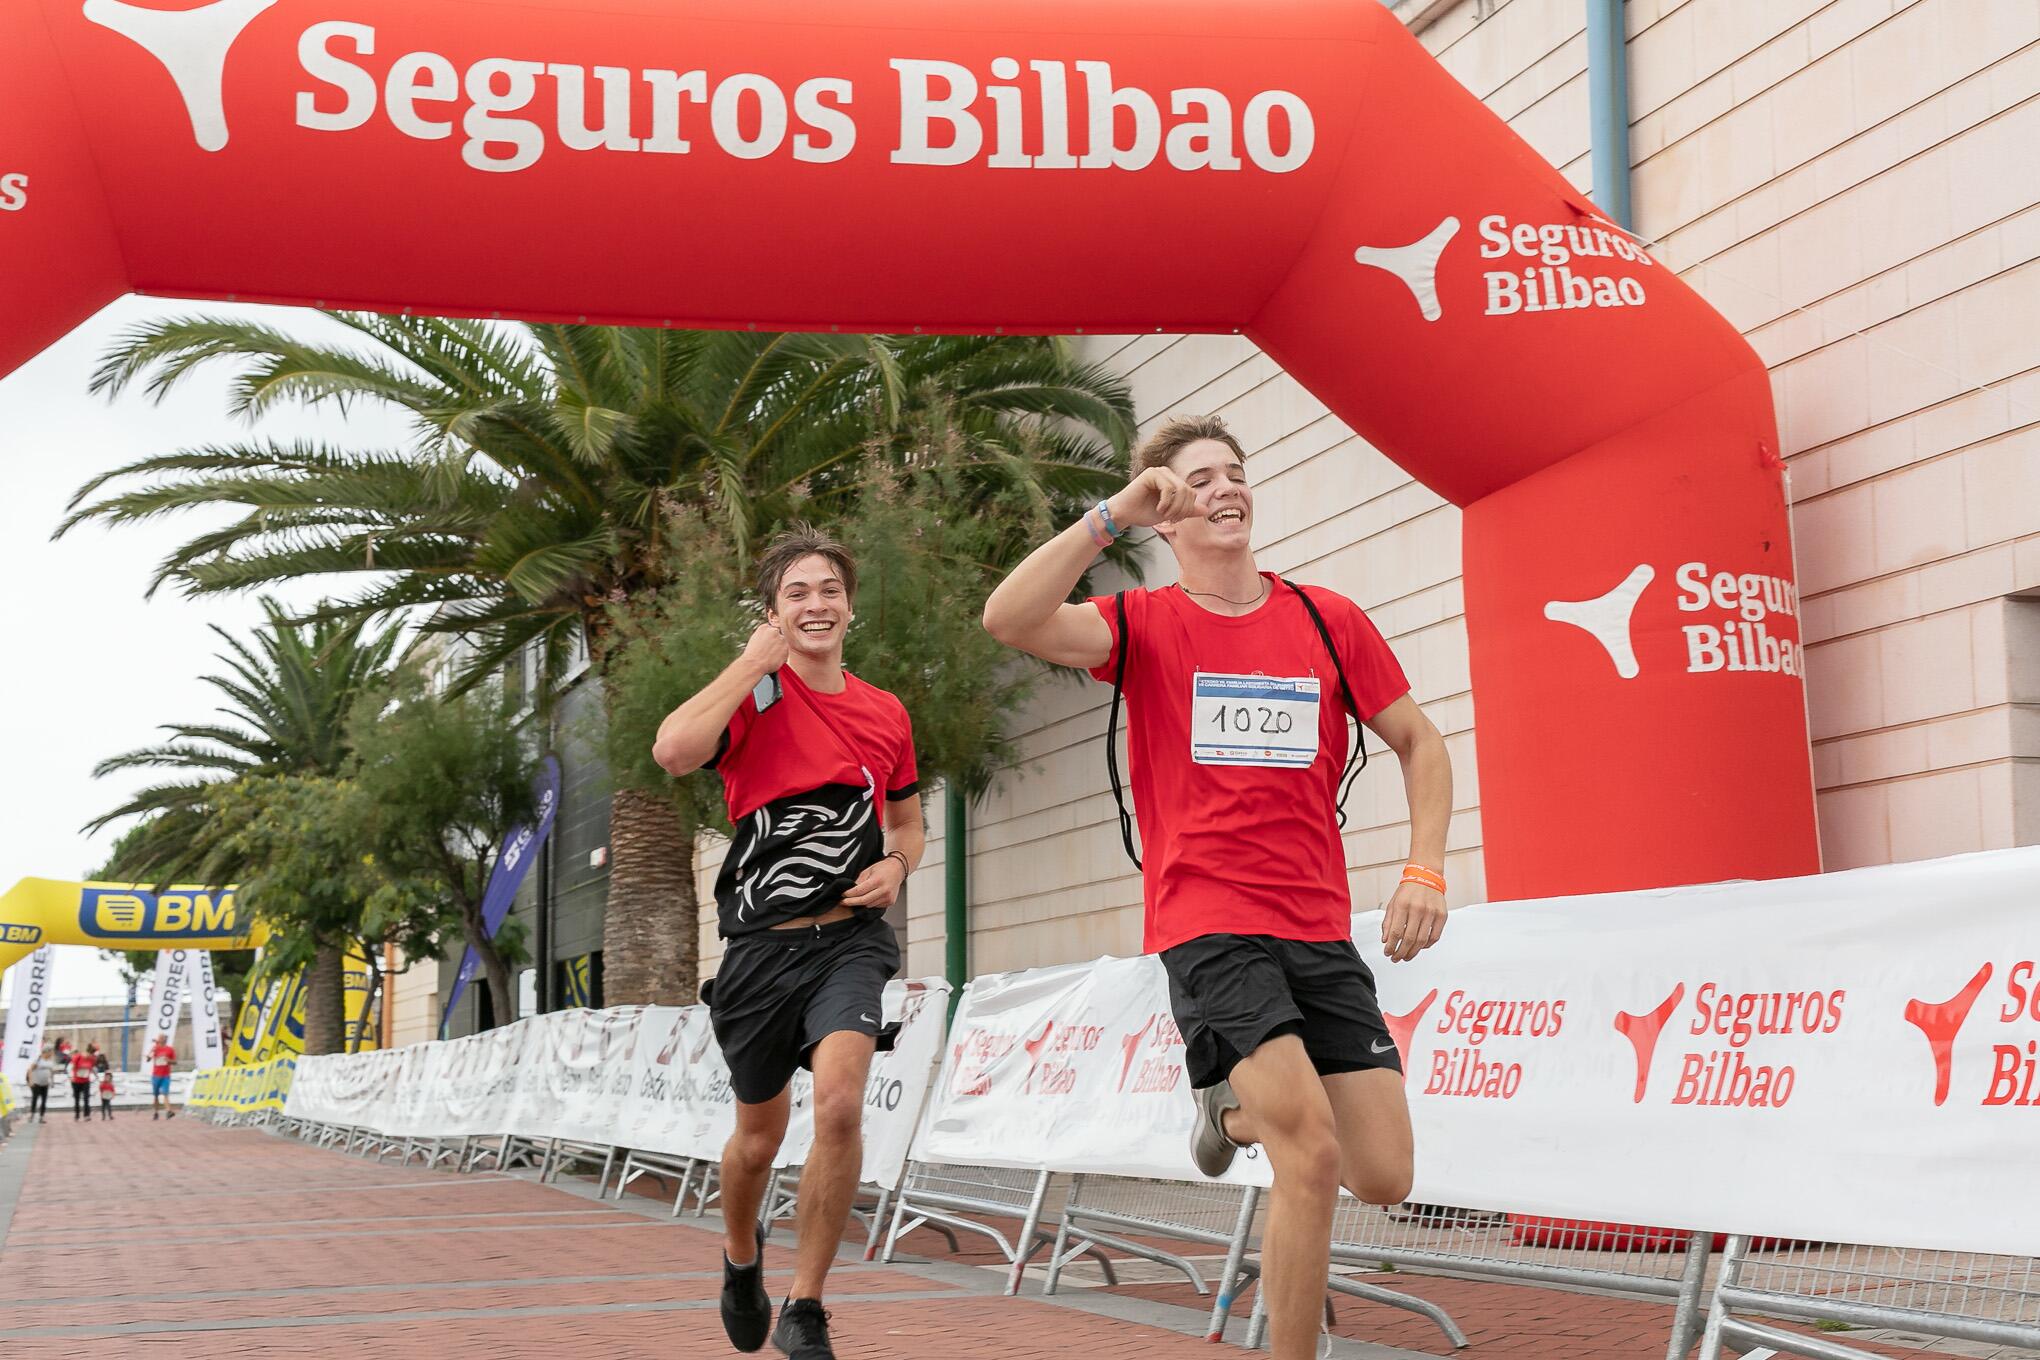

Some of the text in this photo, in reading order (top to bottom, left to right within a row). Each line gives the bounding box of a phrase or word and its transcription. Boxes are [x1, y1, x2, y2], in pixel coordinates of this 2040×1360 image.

[296, 21, 1315, 173] Seguros Bilbao
[1479, 215, 1652, 265] Seguros
[1483, 266, 1646, 315] Bilbao
[1676, 562, 1797, 622] Segur
[1212, 705, 1292, 734] 1020
[6, 927, 39, 942] BM
[154, 893, 236, 931] BM
[26, 948, 48, 1029] CORRE
[159, 949, 187, 1030] CORREO
[1690, 982, 1847, 1048] Seguros
[206, 1022, 217, 1048] EL
[1437, 988, 1566, 1045] Seguros
[1132, 1056, 1182, 1094] Bilbao
[1424, 1047, 1522, 1100] Bilbao
[1671, 1051, 1795, 1108] Bilbao
